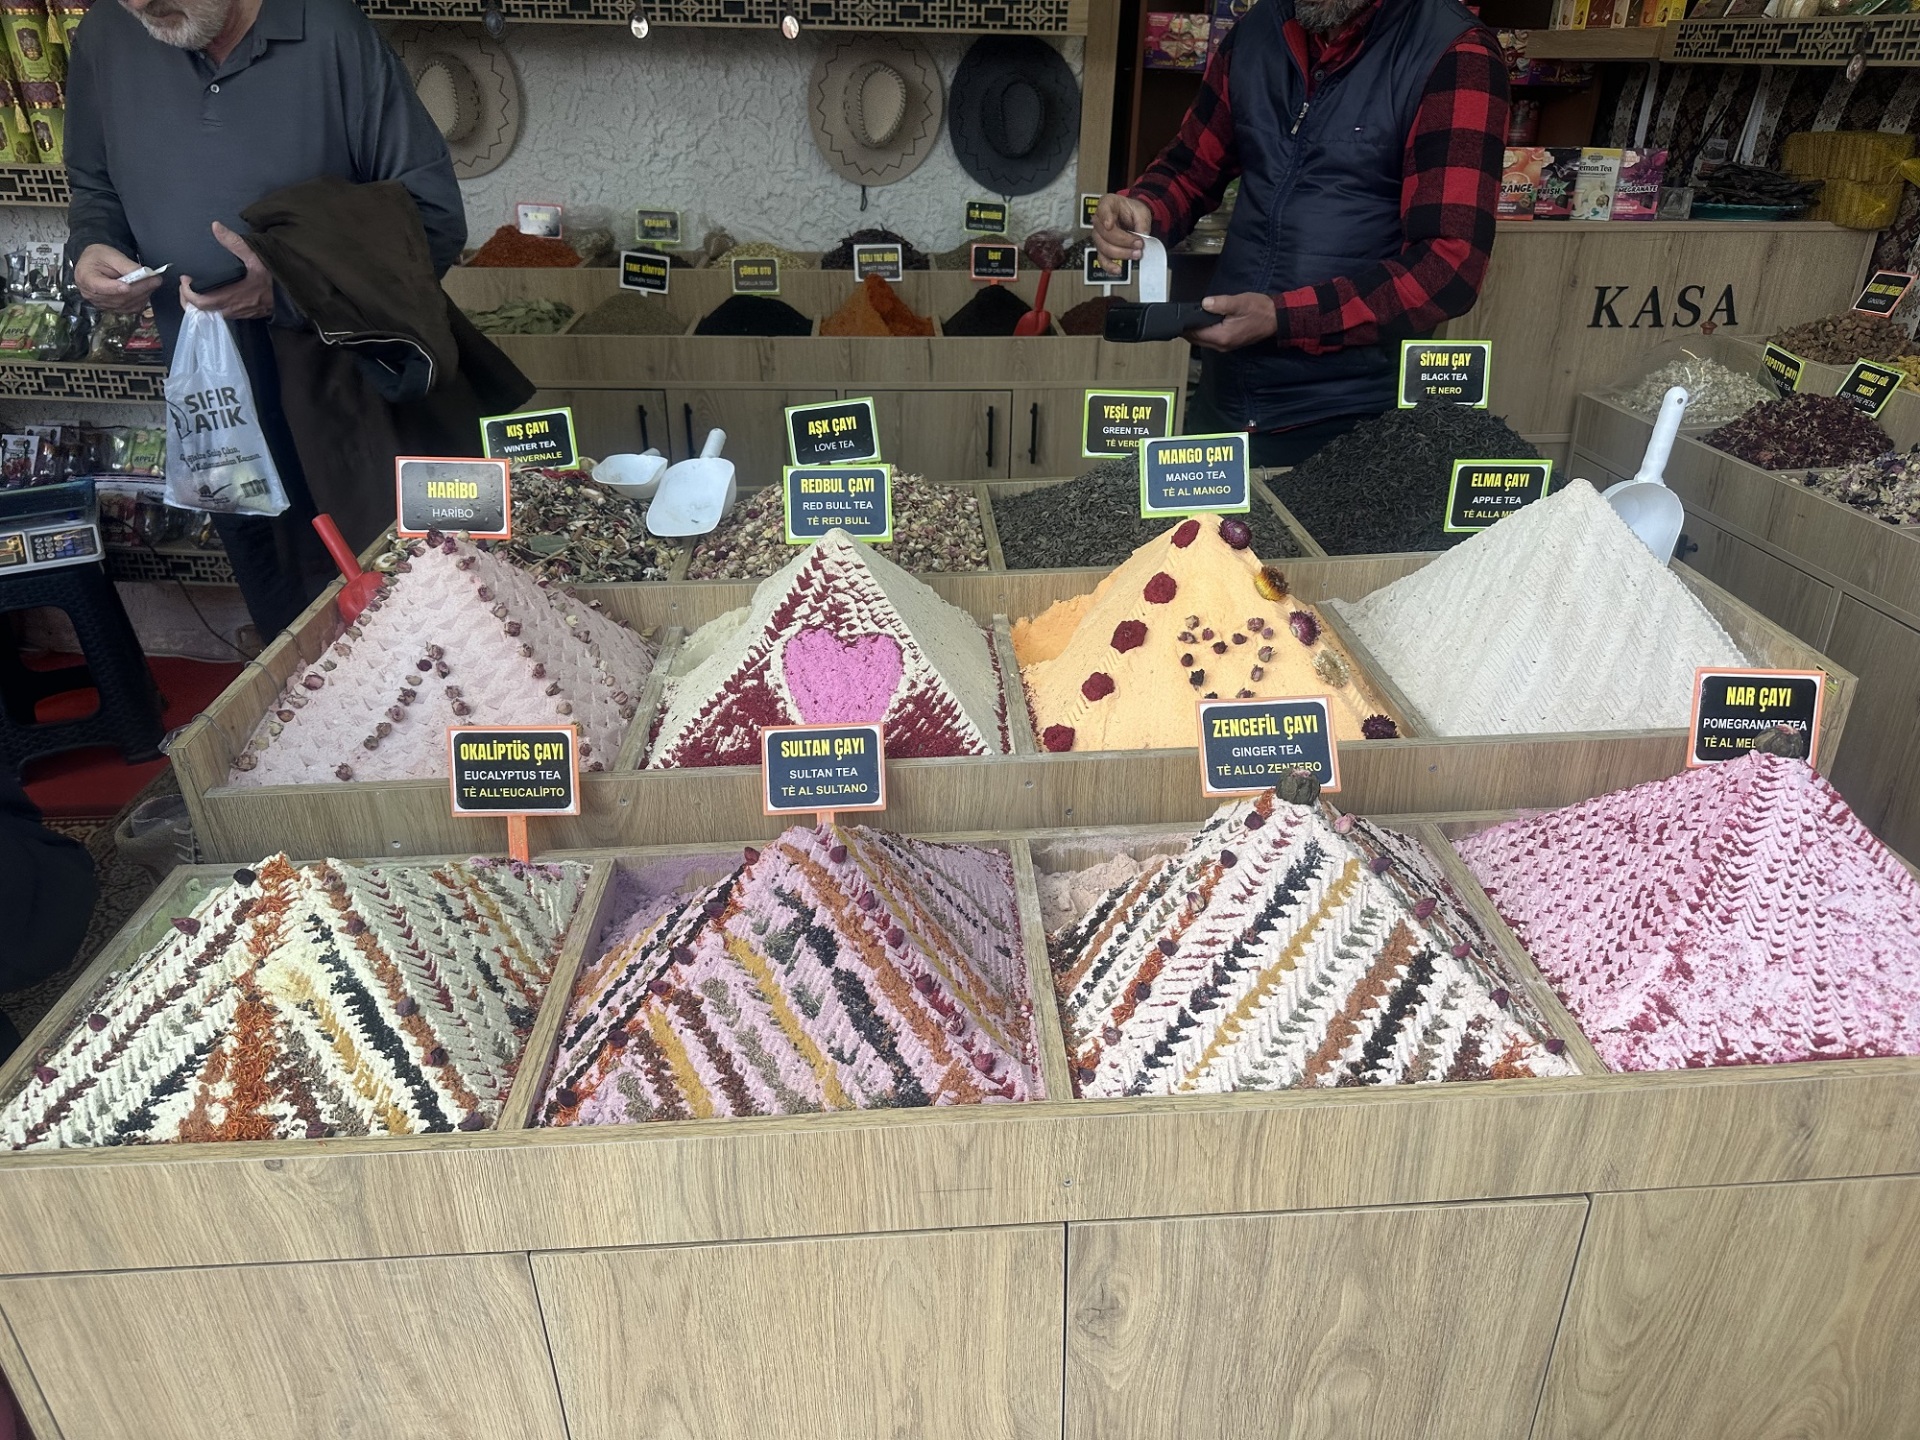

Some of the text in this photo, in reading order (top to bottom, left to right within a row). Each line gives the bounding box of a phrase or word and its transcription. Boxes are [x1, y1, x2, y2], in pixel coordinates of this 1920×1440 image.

[1579, 164, 1612, 172] emon Tea
[1501, 183, 1533, 193] RANGE
[1617, 185, 1658, 193] MEGRANATE
[1587, 284, 1738, 328] KASA
[1420, 350, 1471, 370] SİYAH ÇAY
[1420, 373, 1468, 381] BLACK TEA
[184, 386, 240, 414] SIFIR
[195, 406, 247, 434] ATIK
[1103, 403, 1152, 424] YEŞİL ÇAY
[506, 421, 549, 440] KIŞ ÇAYI
[808, 416, 857, 439] AŞK ÇAYI
[1102, 426, 1150, 435] GREEN TEA
[504, 440, 557, 453] WINTER TEA
[814, 440, 855, 452] LOVE TEA
[1158, 445, 1234, 467] MANGO ÇAYI
[1165, 471, 1227, 482] MANGO TEA
[1471, 473, 1530, 492] ELMA ÇAYI
[427, 479, 478, 499] HARİBO
[800, 477, 875, 497] REDBUL ÇAYI
[1177, 487, 1191, 497] AL
[1193, 485, 1231, 496] MANGO
[803, 500, 873, 510] RED BULL TEA
[1472, 496, 1522, 504] APPLE TEA
[822, 517, 842, 525] RED
[845, 516, 871, 525] BULL
[1476, 510, 1500, 518] ALLA
[1726, 686, 1792, 712] NAR ÇAYI
[1212, 713, 1318, 740] ZENCEFİL ÇAYI
[1787, 720, 1807, 731] TEA
[781, 737, 865, 761] SULTAN ÇAYI
[1719, 737, 1733, 748] AL
[460, 739, 564, 765] OKALİPTÜS ÇAYI
[1232, 744, 1303, 757] GINGER TEA
[464, 770, 561, 780] EUCALYPTUS TEA
[789, 767, 858, 779] SULTAN TEA
[1234, 764, 1265, 775] ALLO
[798, 786, 813, 796] AL
[816, 783, 868, 795] SULTANO
